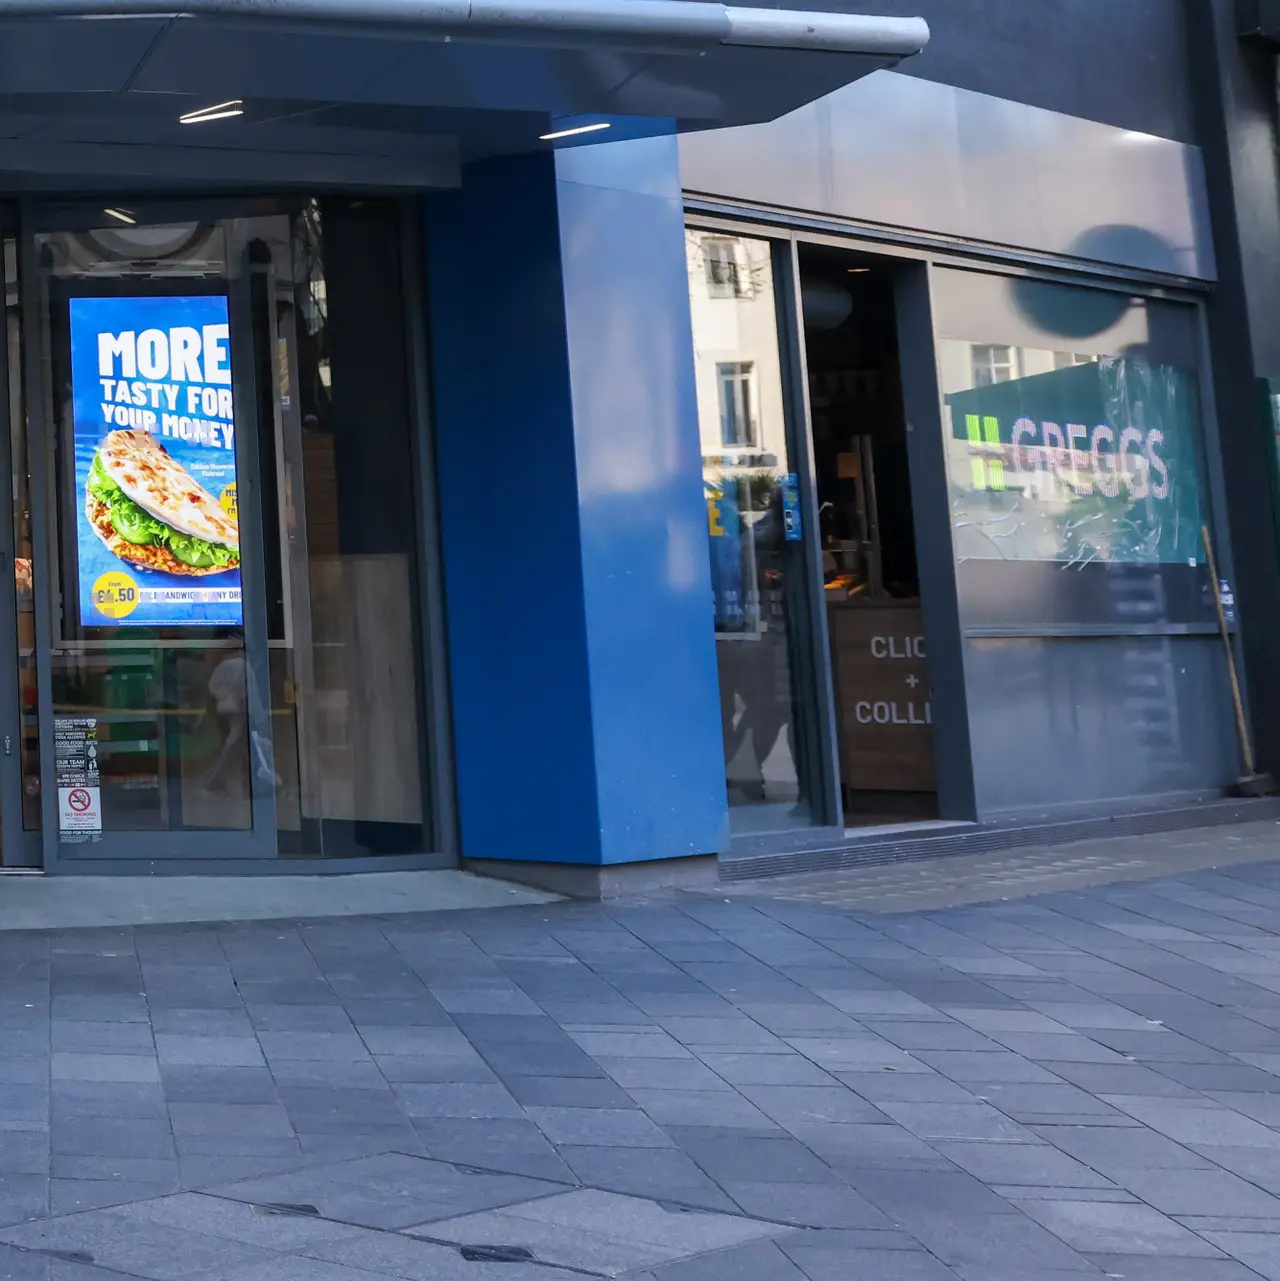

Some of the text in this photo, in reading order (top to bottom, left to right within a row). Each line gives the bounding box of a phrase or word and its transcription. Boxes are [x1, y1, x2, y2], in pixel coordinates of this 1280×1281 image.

[97, 323, 232, 385] MORE
[99, 378, 234, 420] TASTY FOR
[161, 412, 235, 451] MONEY
[1011, 415, 1169, 500] GREGGS
[98, 587, 135, 604] £.50
[870, 635, 927, 659] CLIC
